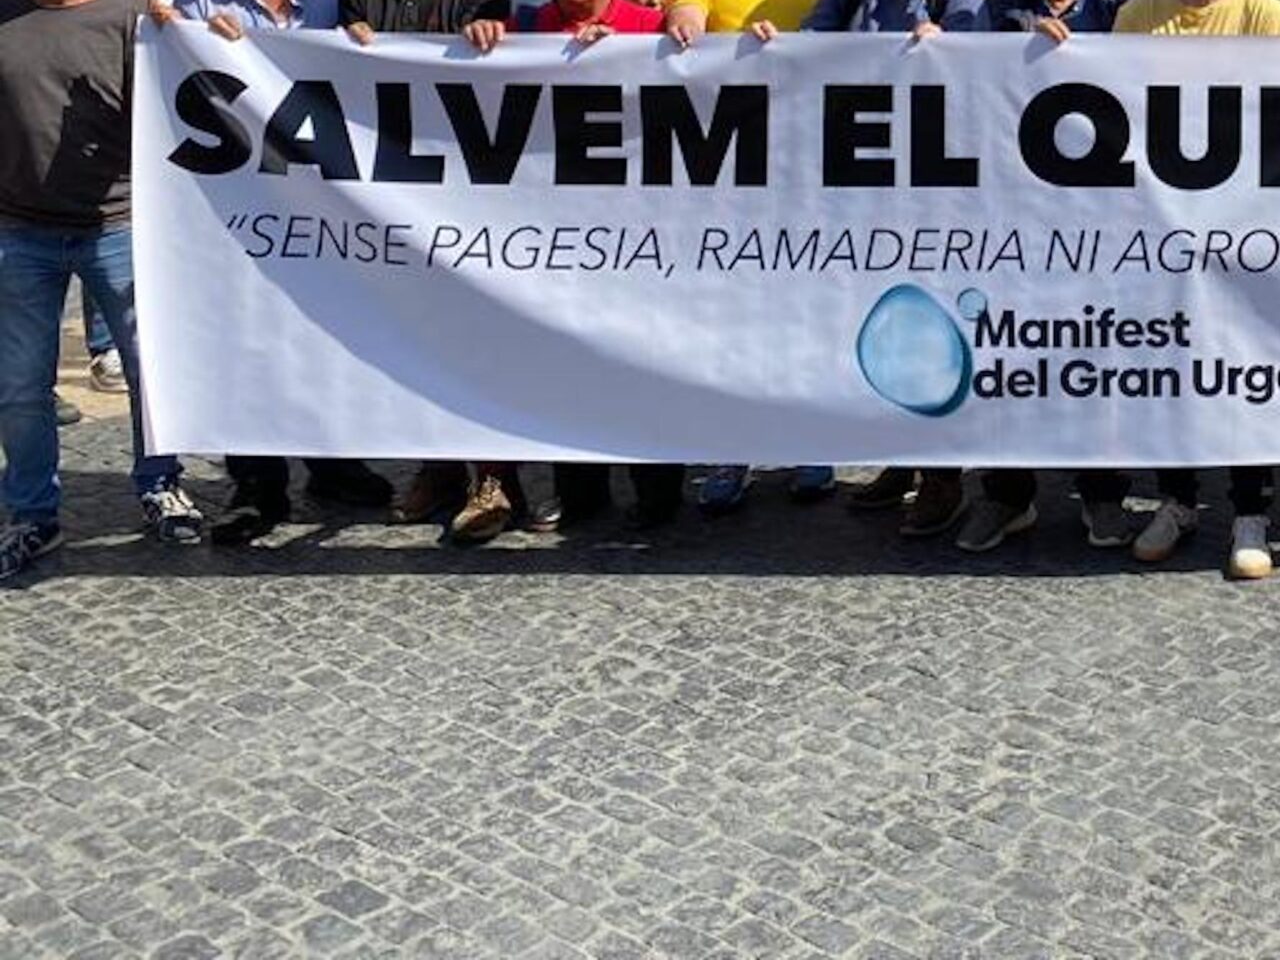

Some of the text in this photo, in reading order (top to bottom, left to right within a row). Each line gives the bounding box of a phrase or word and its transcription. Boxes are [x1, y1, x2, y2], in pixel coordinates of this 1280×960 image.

[167, 70, 769, 187] SALVEM
[822, 84, 979, 188] EL
[426, 225, 676, 280] PAGESIA,
[696, 227, 1027, 274] RAMADERIA
[1045, 228, 1102, 274] NI
[973, 306, 1191, 349] Manifest
[973, 359, 1048, 398] del
[1060, 361, 1180, 398] Gran
